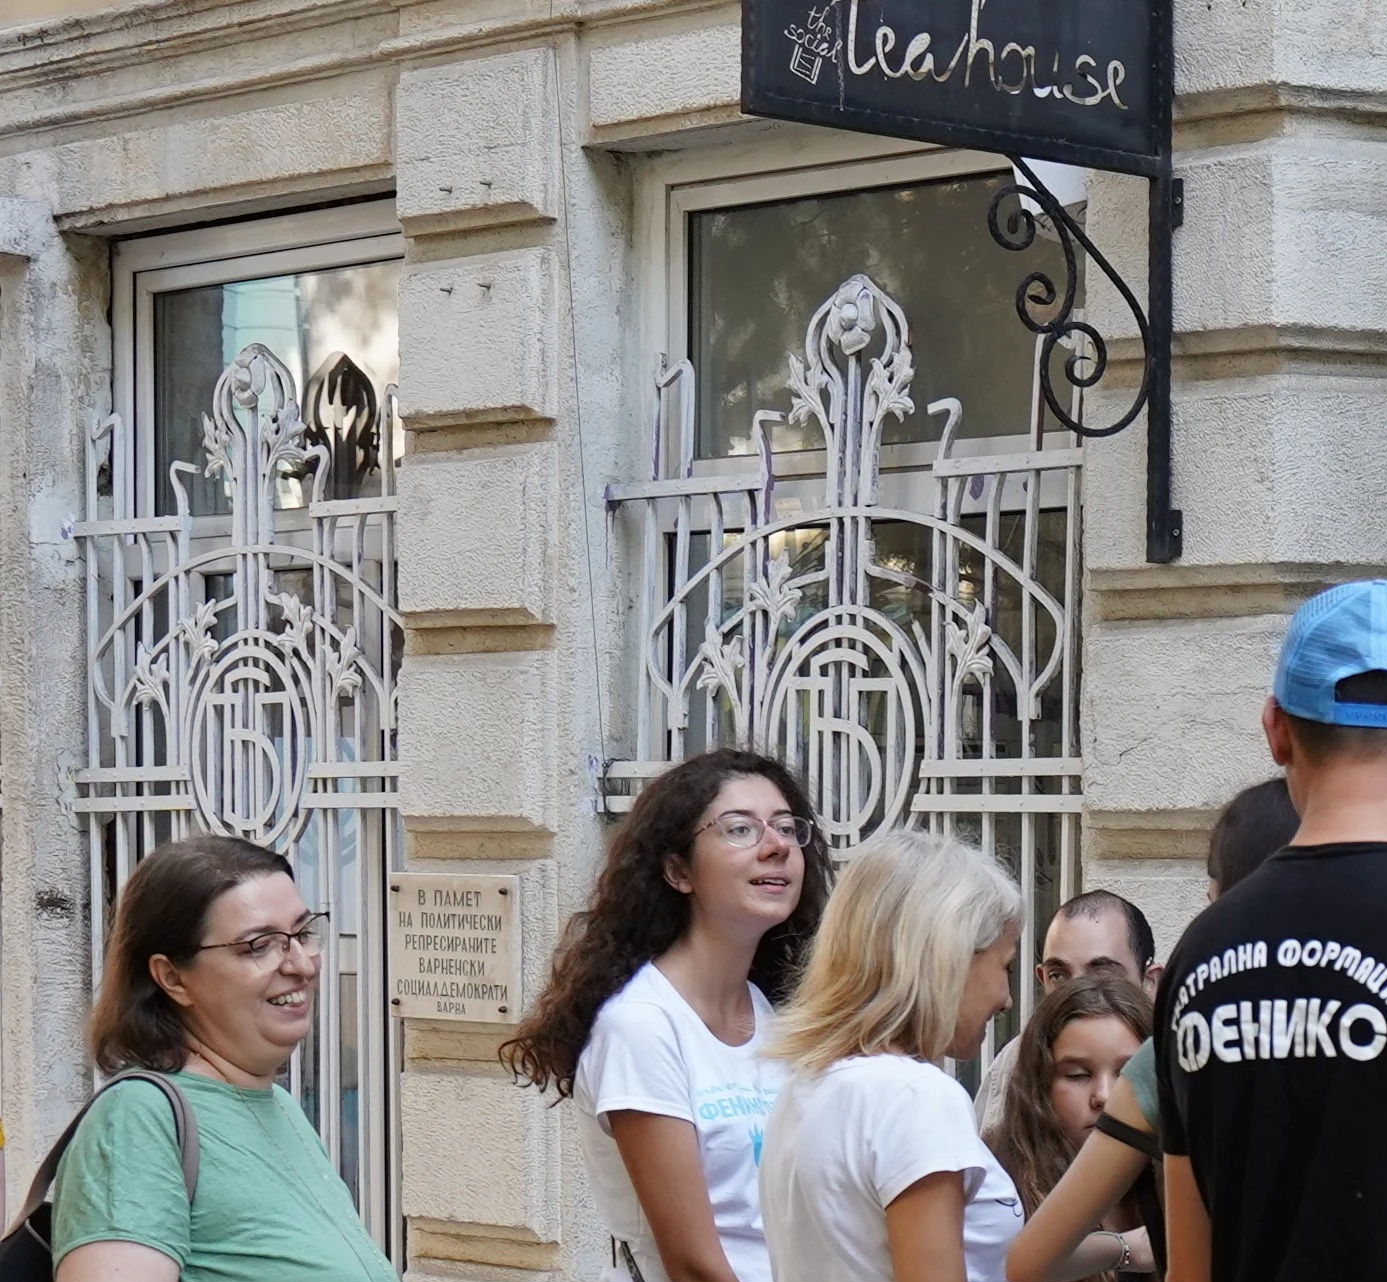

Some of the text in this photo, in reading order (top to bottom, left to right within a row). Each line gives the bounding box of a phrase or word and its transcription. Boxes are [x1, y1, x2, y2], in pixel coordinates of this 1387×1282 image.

[808, 6, 832, 41] the
[784, 24, 843, 63] social
[418, 889, 482, 908] В ПАМЕТ
[399, 911, 502, 931] НА ПОЛИТИЧЕСКИ
[404, 933, 497, 954] РЕПРЕСИРАНИТЕ
[418, 957, 486, 977] ВАРНЕНСКИ
[397, 979, 508, 1001] СОЦИАЛДЕМОКРАТИ
[437, 1002, 466, 1015] ВАРНА
